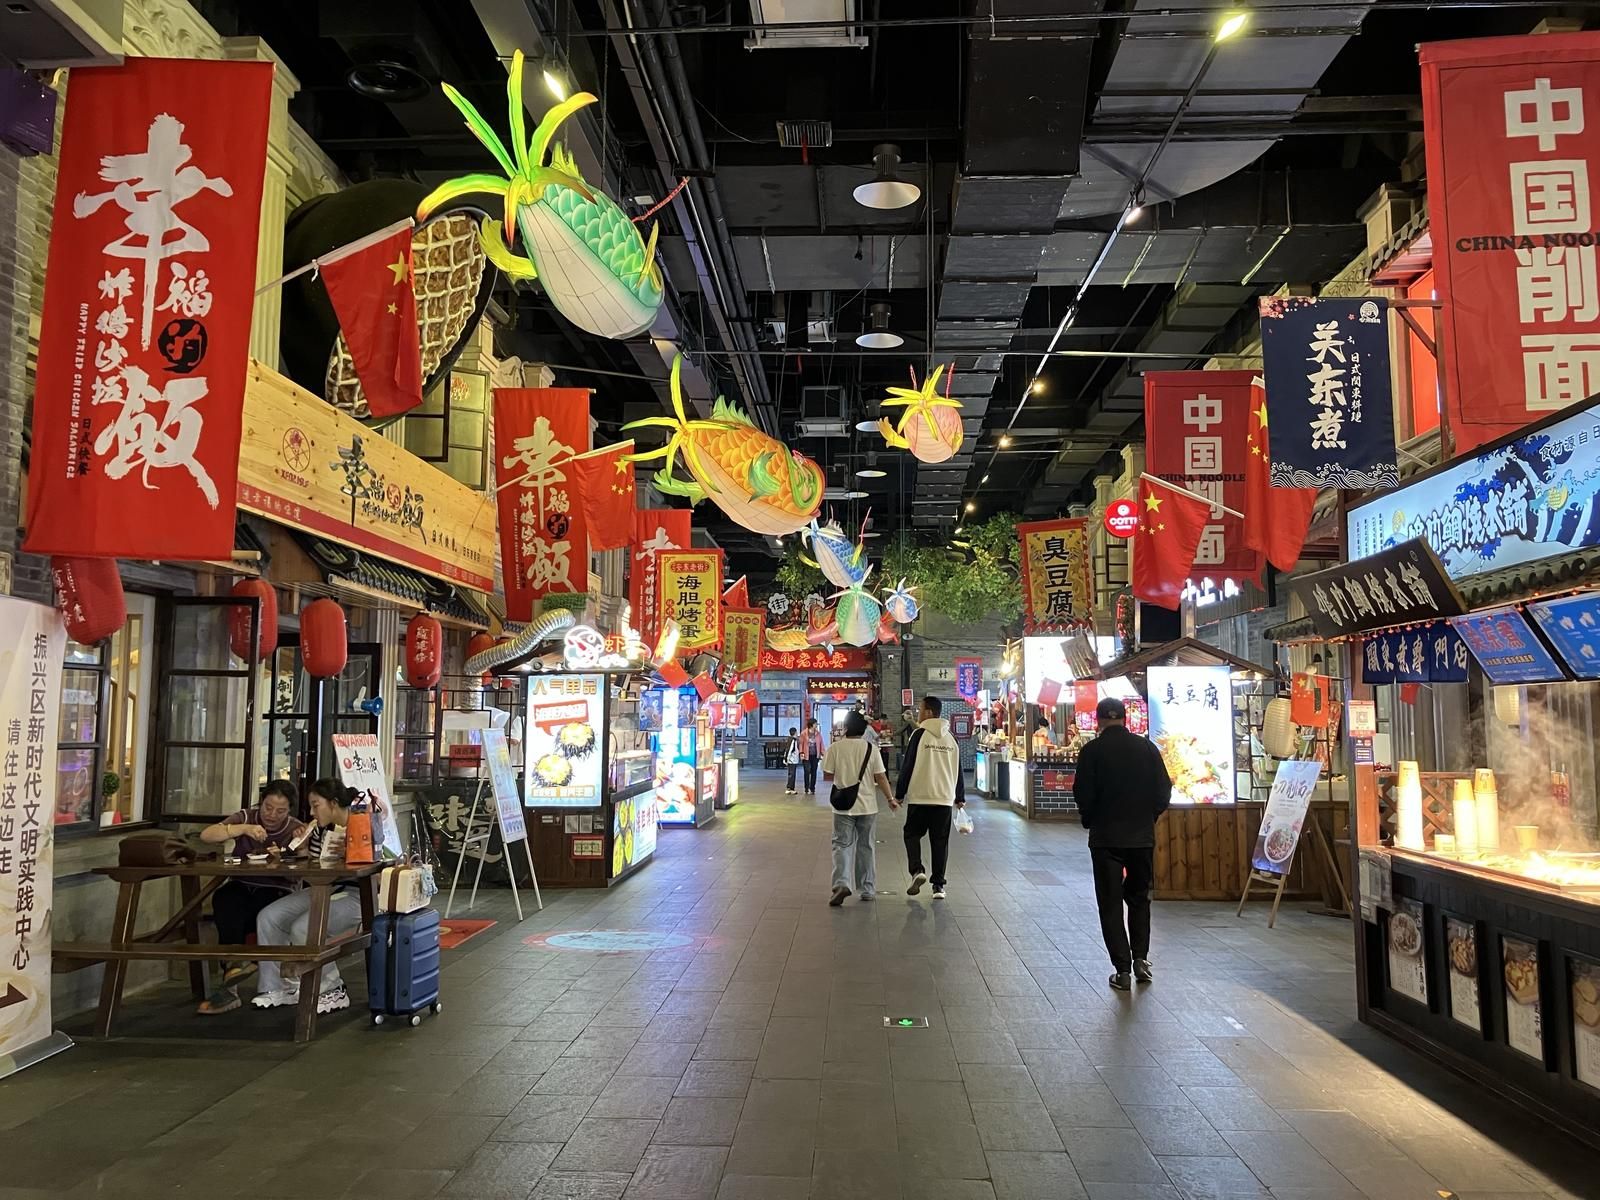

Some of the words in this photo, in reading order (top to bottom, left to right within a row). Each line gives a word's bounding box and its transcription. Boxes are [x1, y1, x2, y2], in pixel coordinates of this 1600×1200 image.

[1456, 235, 1536, 252] CHINA
[1504, 78, 1600, 412] 中国削面
[77, 303, 89, 334] HAPPY
[75, 338, 86, 369] FRIED
[71, 374, 82, 418] CHICKEN
[1306, 320, 1347, 449] 关东煮
[1158, 473, 1194, 482] CHINA
[1200, 473, 1246, 482] NOODLE
[1042, 536, 1073, 615] 臭豆腐
[677, 575, 702, 638] 海胆烤蛋
[533, 678, 597, 696] 人气单品
[1162, 682, 1219, 711] 臭豆腐
[350, 735, 378, 747] ARRIVAL
[0, 719, 21, 874] 请往这边走
[12, 633, 48, 971] 振兴区新时代文明实践中心
